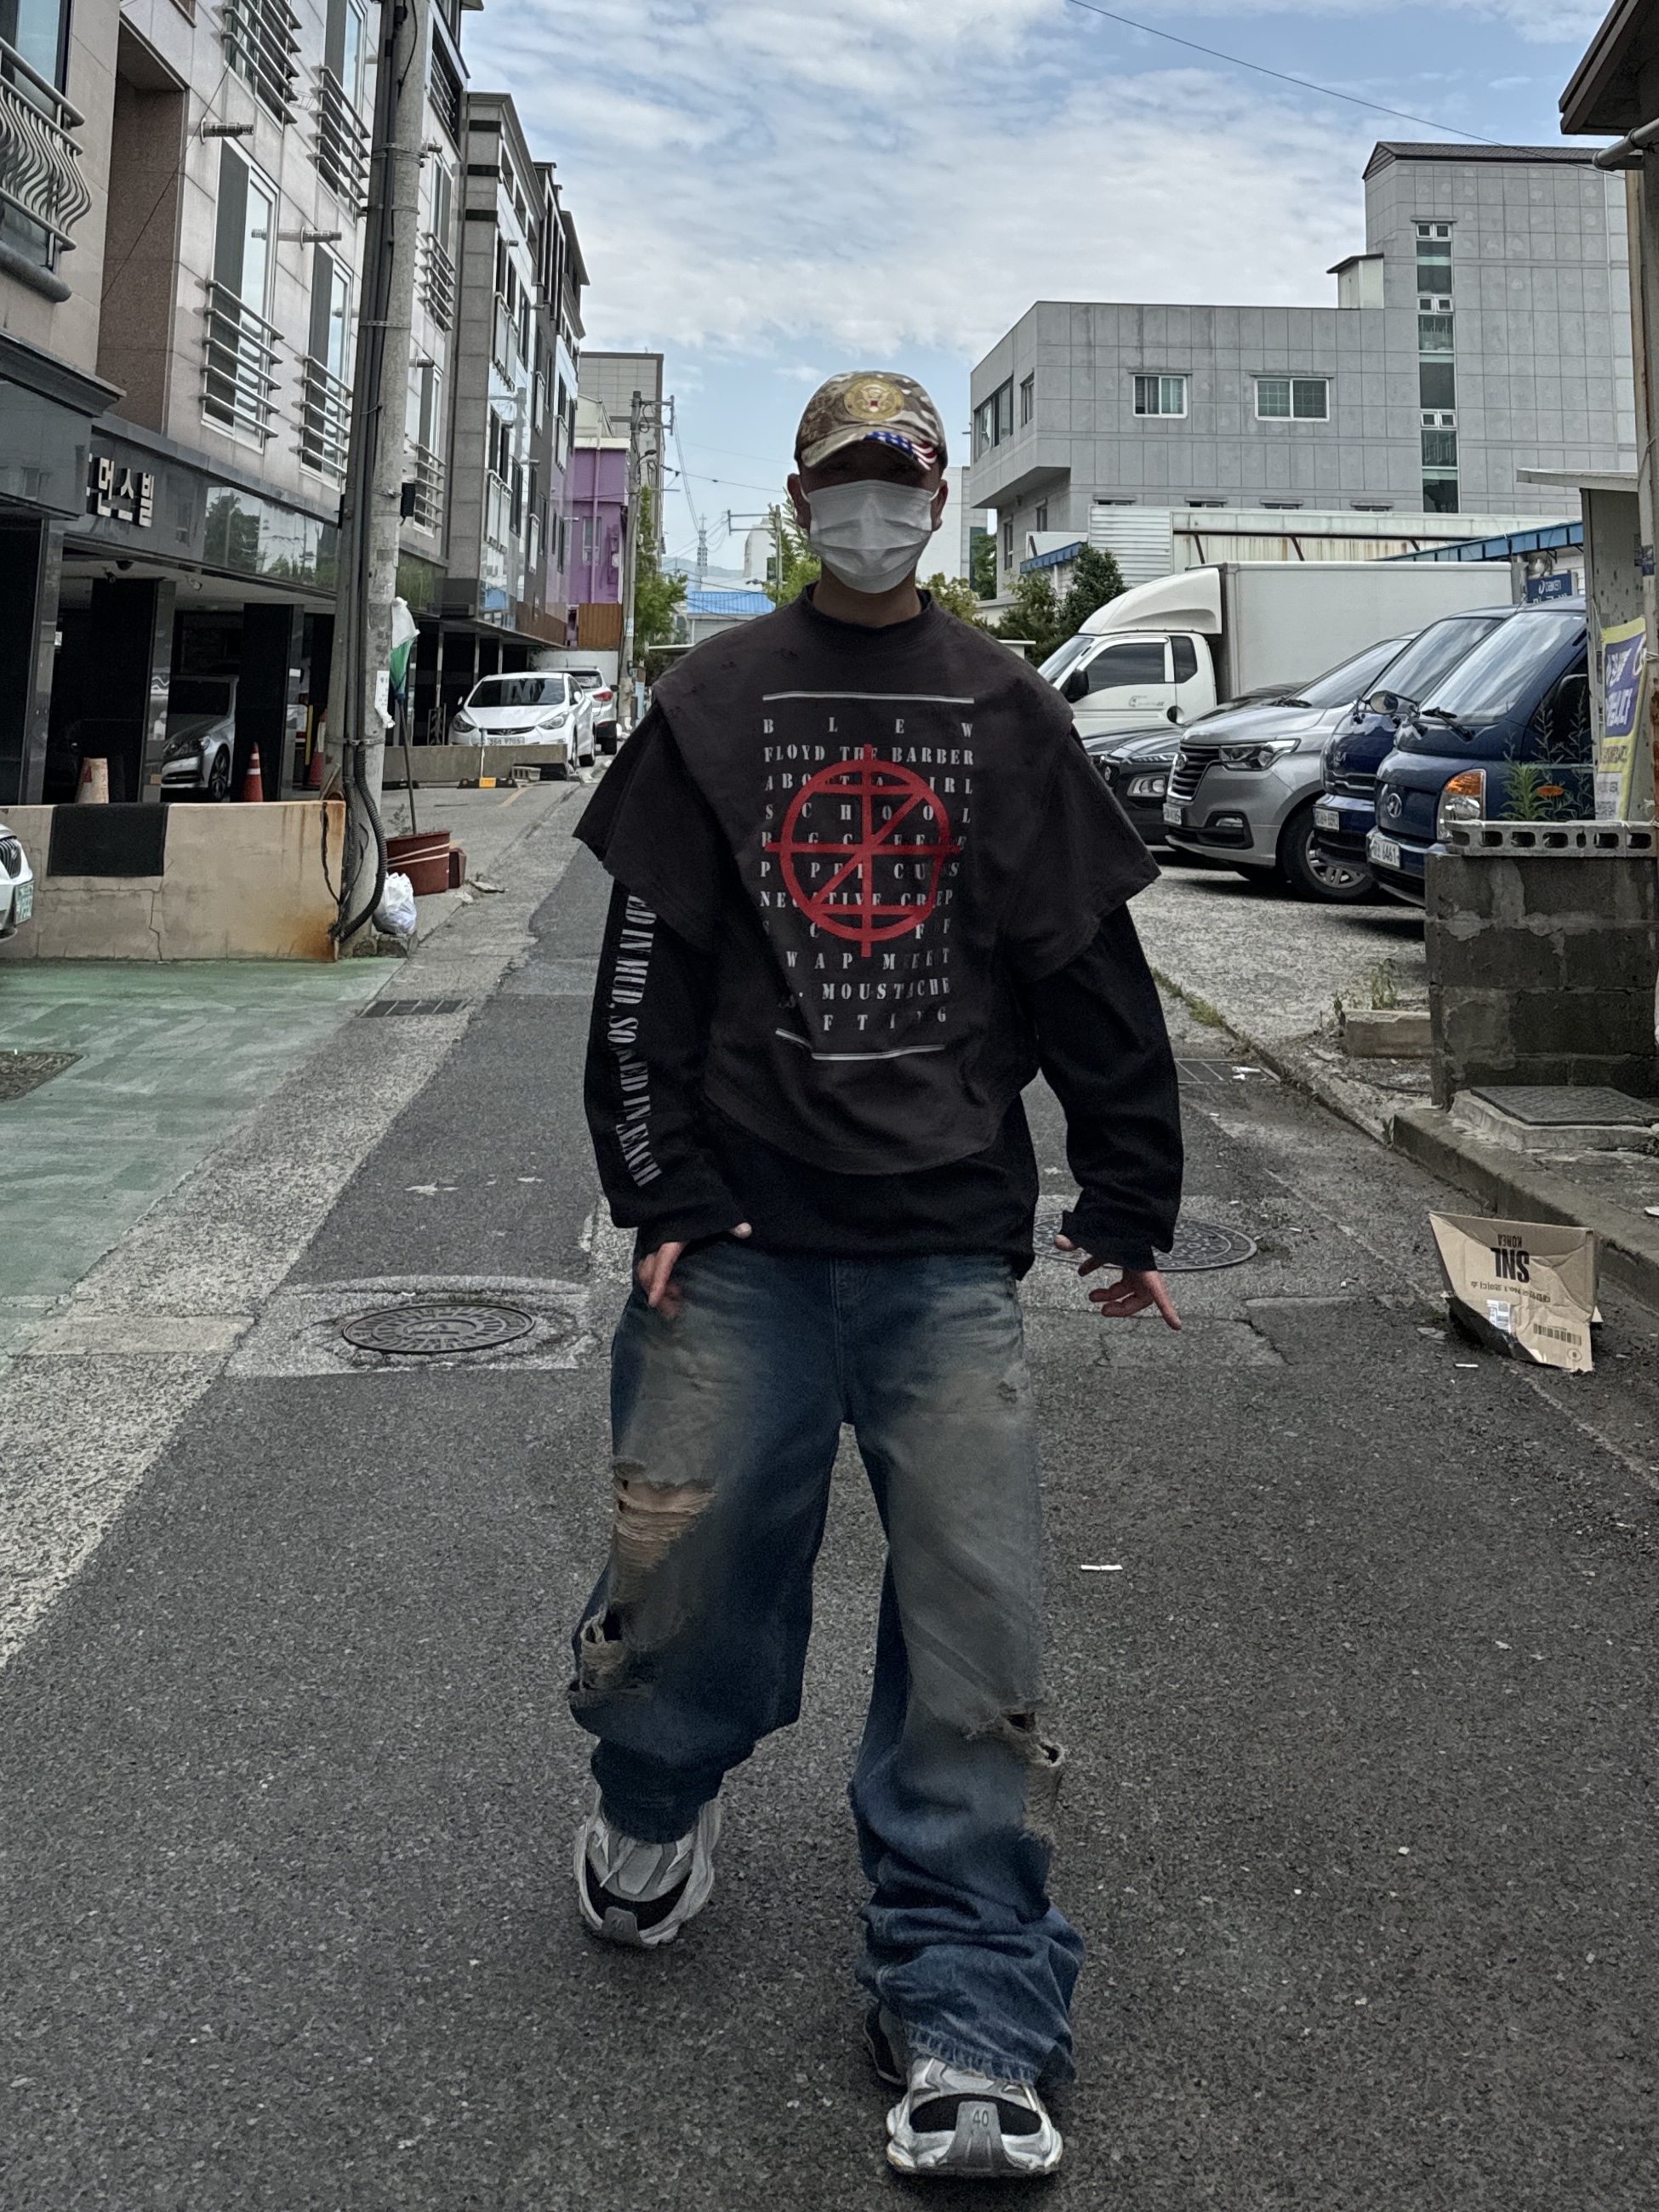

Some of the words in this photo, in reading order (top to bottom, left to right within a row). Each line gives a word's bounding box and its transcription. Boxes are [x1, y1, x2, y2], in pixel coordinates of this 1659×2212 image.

[87, 453, 155, 527] 먼스빌
[764, 744, 825, 762] FLOYD
[840, 745, 878, 761] THE
[892, 747, 974, 766] BARBER
[765, 772, 850, 791] ABOT
[929, 775, 972, 795] IRL
[761, 831, 819, 848] BG
[893, 862, 960, 880] CUS
[619, 928, 653, 954] IN
[786, 950, 853, 970] WAP
[822, 978, 951, 1001] MOUSTACHE
[619, 1095, 651, 1121] IN
[1497, 1234, 1522, 1249] KOREA
[1491, 1247, 1531, 1284] SNL
[1479, 1281, 1502, 1291] 코미디
[1503, 1286, 1521, 1295] No.1
[972, 2109, 989, 2128] 40
